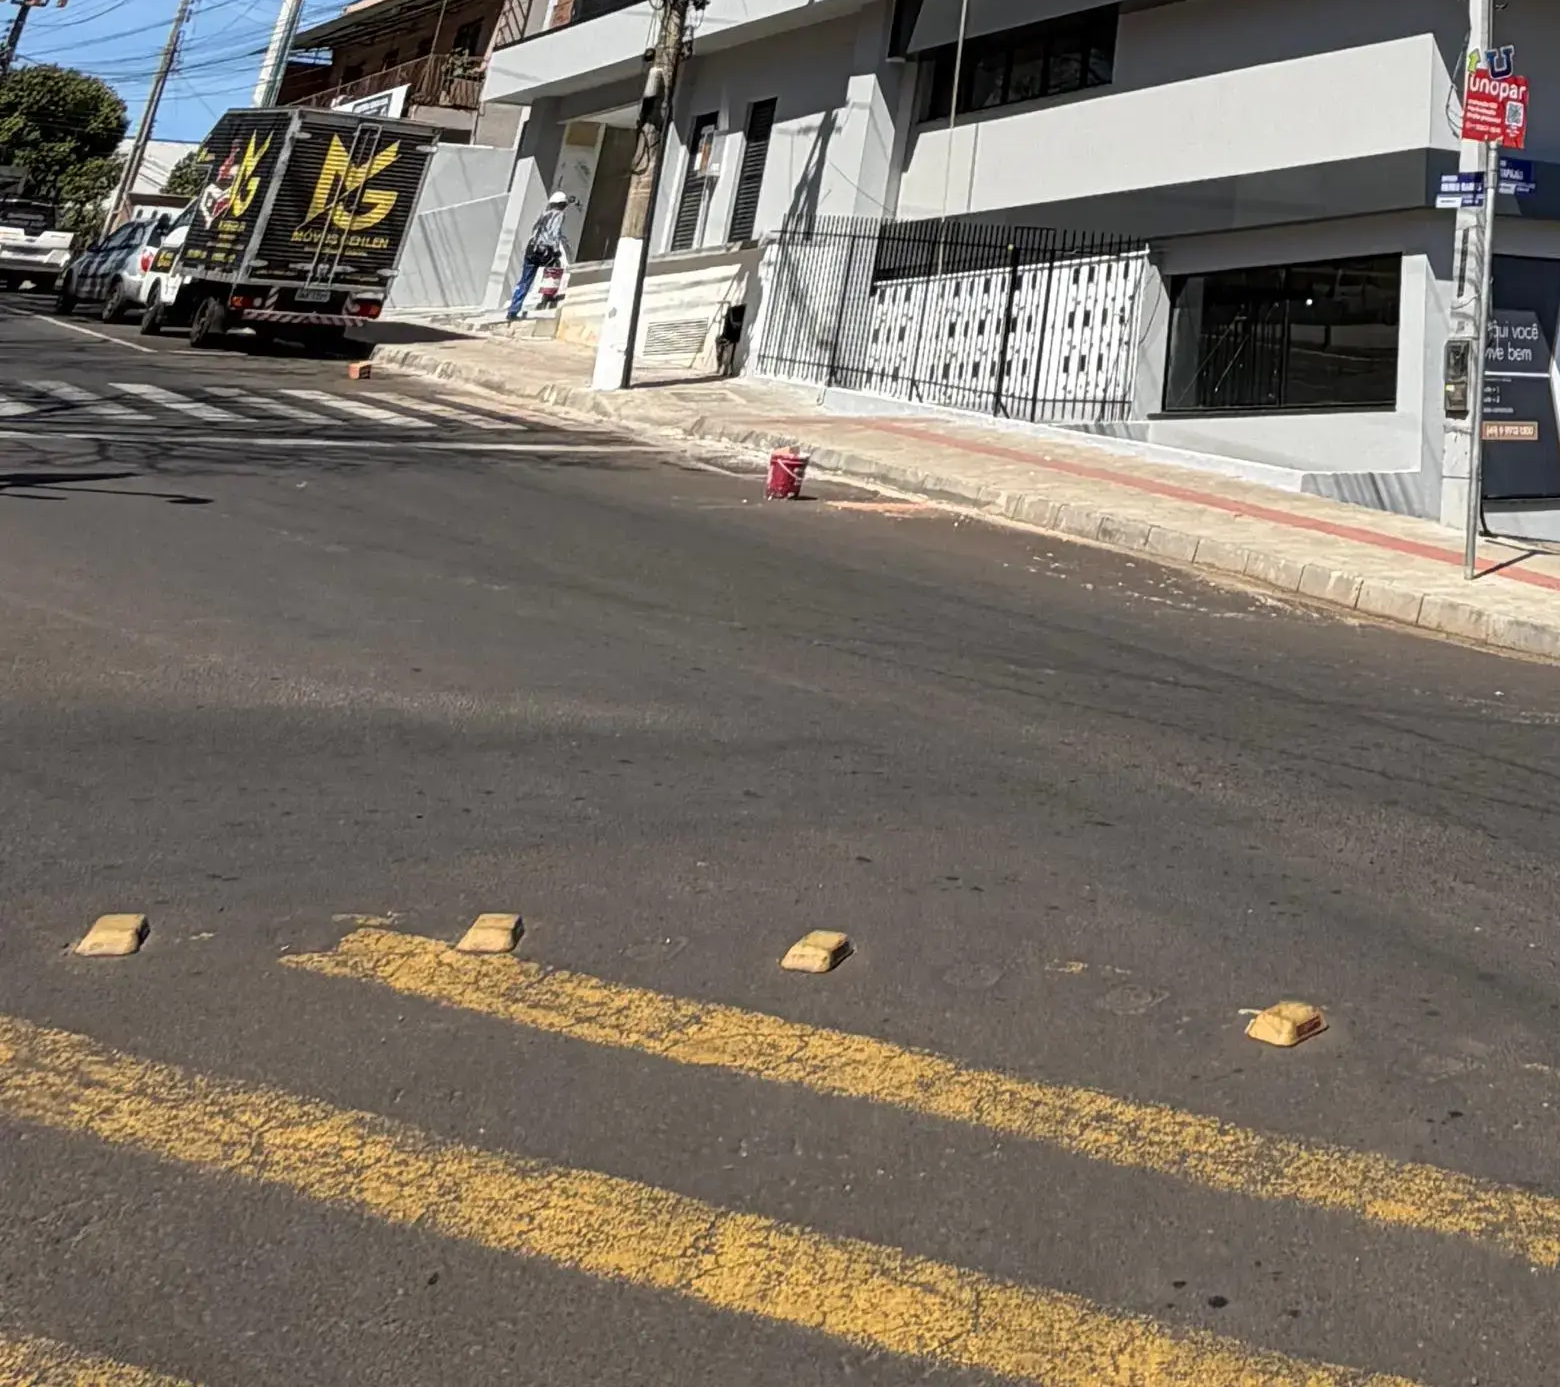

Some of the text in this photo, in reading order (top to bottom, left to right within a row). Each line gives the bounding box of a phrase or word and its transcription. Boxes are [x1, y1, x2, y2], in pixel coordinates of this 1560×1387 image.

[1470, 74, 1526, 101] unopar
[291, 228, 339, 244] MÓVIS
[1512, 323, 1538, 340] você
[1508, 342, 1532, 361] bem
